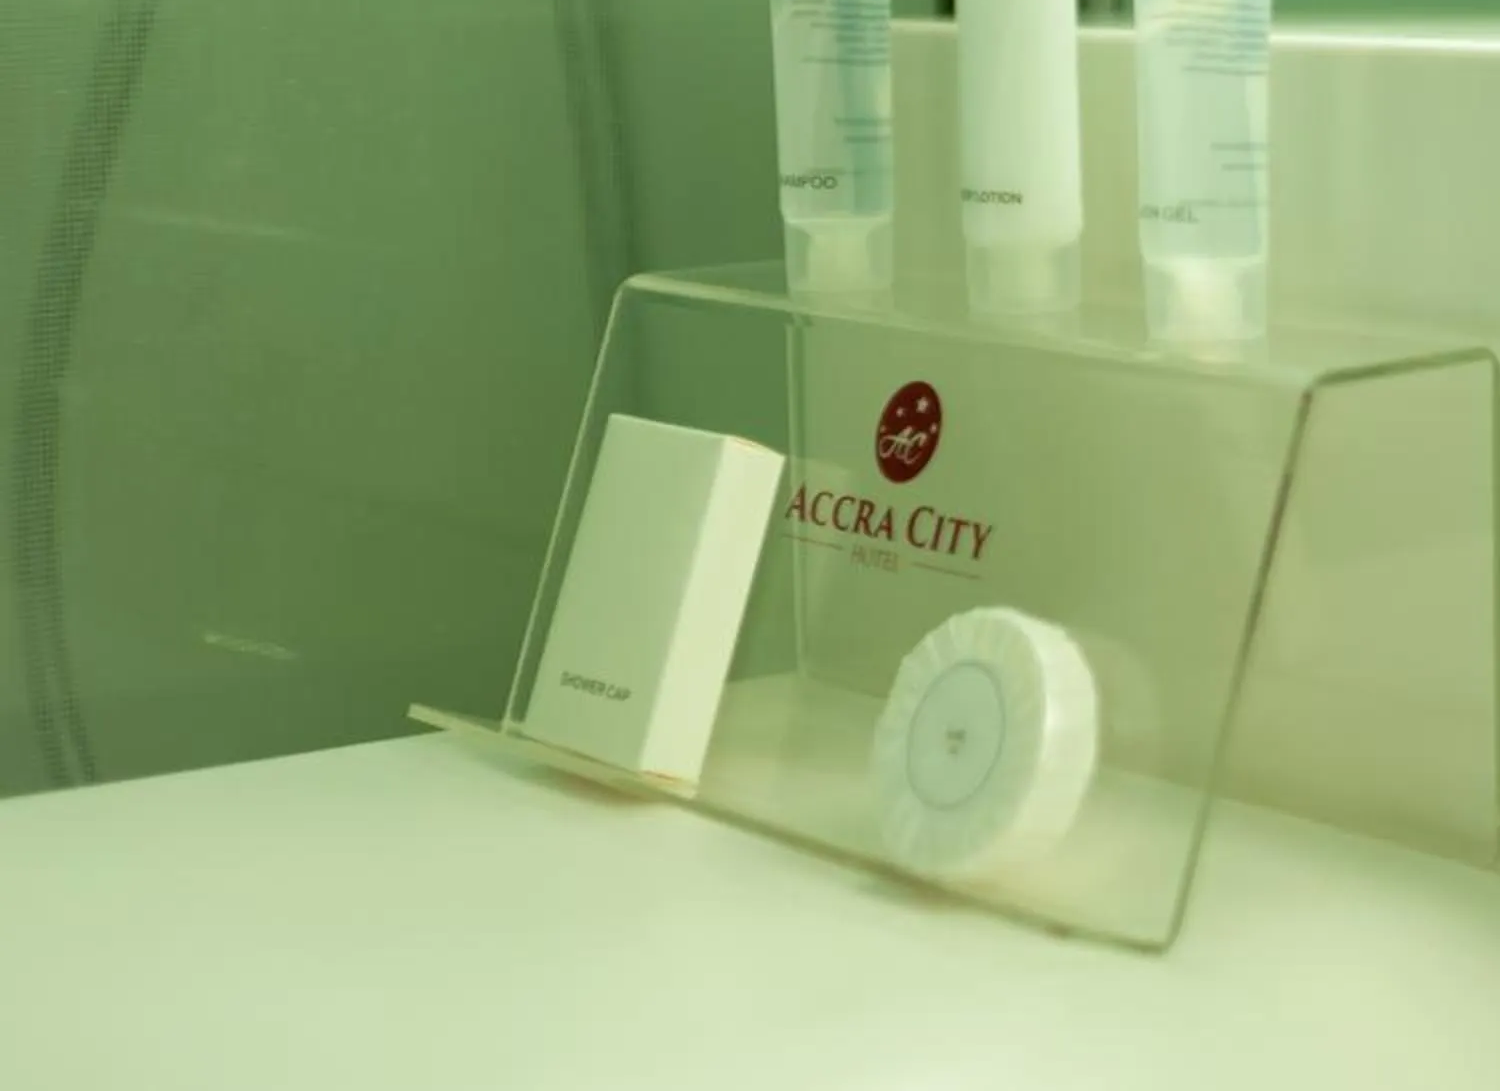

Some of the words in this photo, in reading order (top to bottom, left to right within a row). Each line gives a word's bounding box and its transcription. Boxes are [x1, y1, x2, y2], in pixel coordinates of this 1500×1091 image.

[784, 482, 895, 541] ACCRA
[906, 505, 993, 561] CITY
[851, 543, 900, 574] HOTEL
